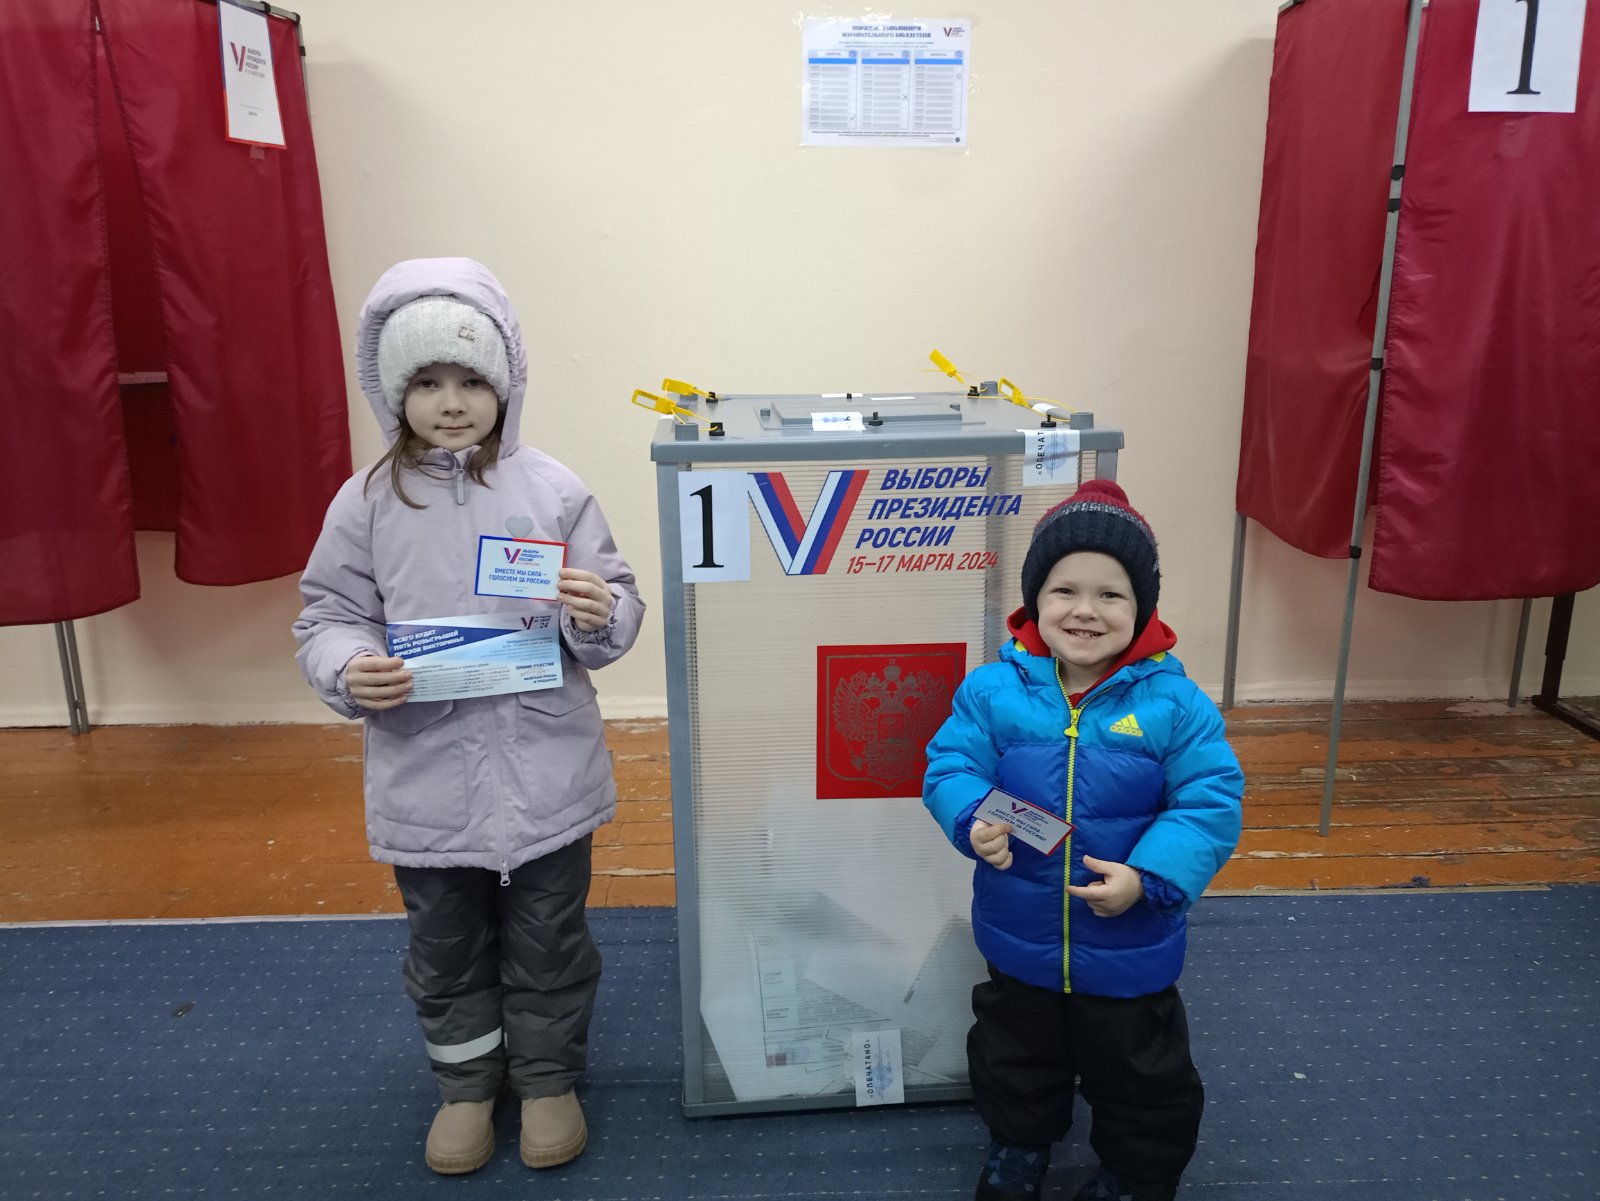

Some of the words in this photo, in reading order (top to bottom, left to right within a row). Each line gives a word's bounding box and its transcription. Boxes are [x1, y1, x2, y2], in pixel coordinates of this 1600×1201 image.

[1506, 0, 1541, 95] 1
[1036, 432, 1046, 475] «ОПЕЧАТ
[880, 466, 992, 491] ВЫБОРЫ
[868, 494, 1023, 521] ПРЕЗИДЕНТА
[690, 484, 725, 568] 1
[855, 525, 955, 550] РОССИИ
[494, 567, 516, 575] ВМЕСТЕ
[897, 552, 959, 573] МАРТА
[961, 551, 999, 570] 2024
[489, 574, 518, 582] ГОЛОСУЕМ
[526, 577, 551, 585] РОССИЮ!
[539, 620, 549, 629] 24
[392, 634, 414, 644] ВСЕГО
[415, 629, 436, 639] БУДЕТ
[393, 643, 412, 651] ПЯТЬ
[412, 630, 459, 647] РОЗЫГРЫШЕЙ
[394, 647, 422, 657] ПРИЗОВ
[1110, 724, 1143, 737] adidas
[995, 808, 1015, 821] ВМЕСТЕ
[1016, 818, 1027, 826] МЫ
[1026, 823, 1041, 834] СИЛА
[863, 1038, 874, 1099] «ОПЕЧАТАНО»
